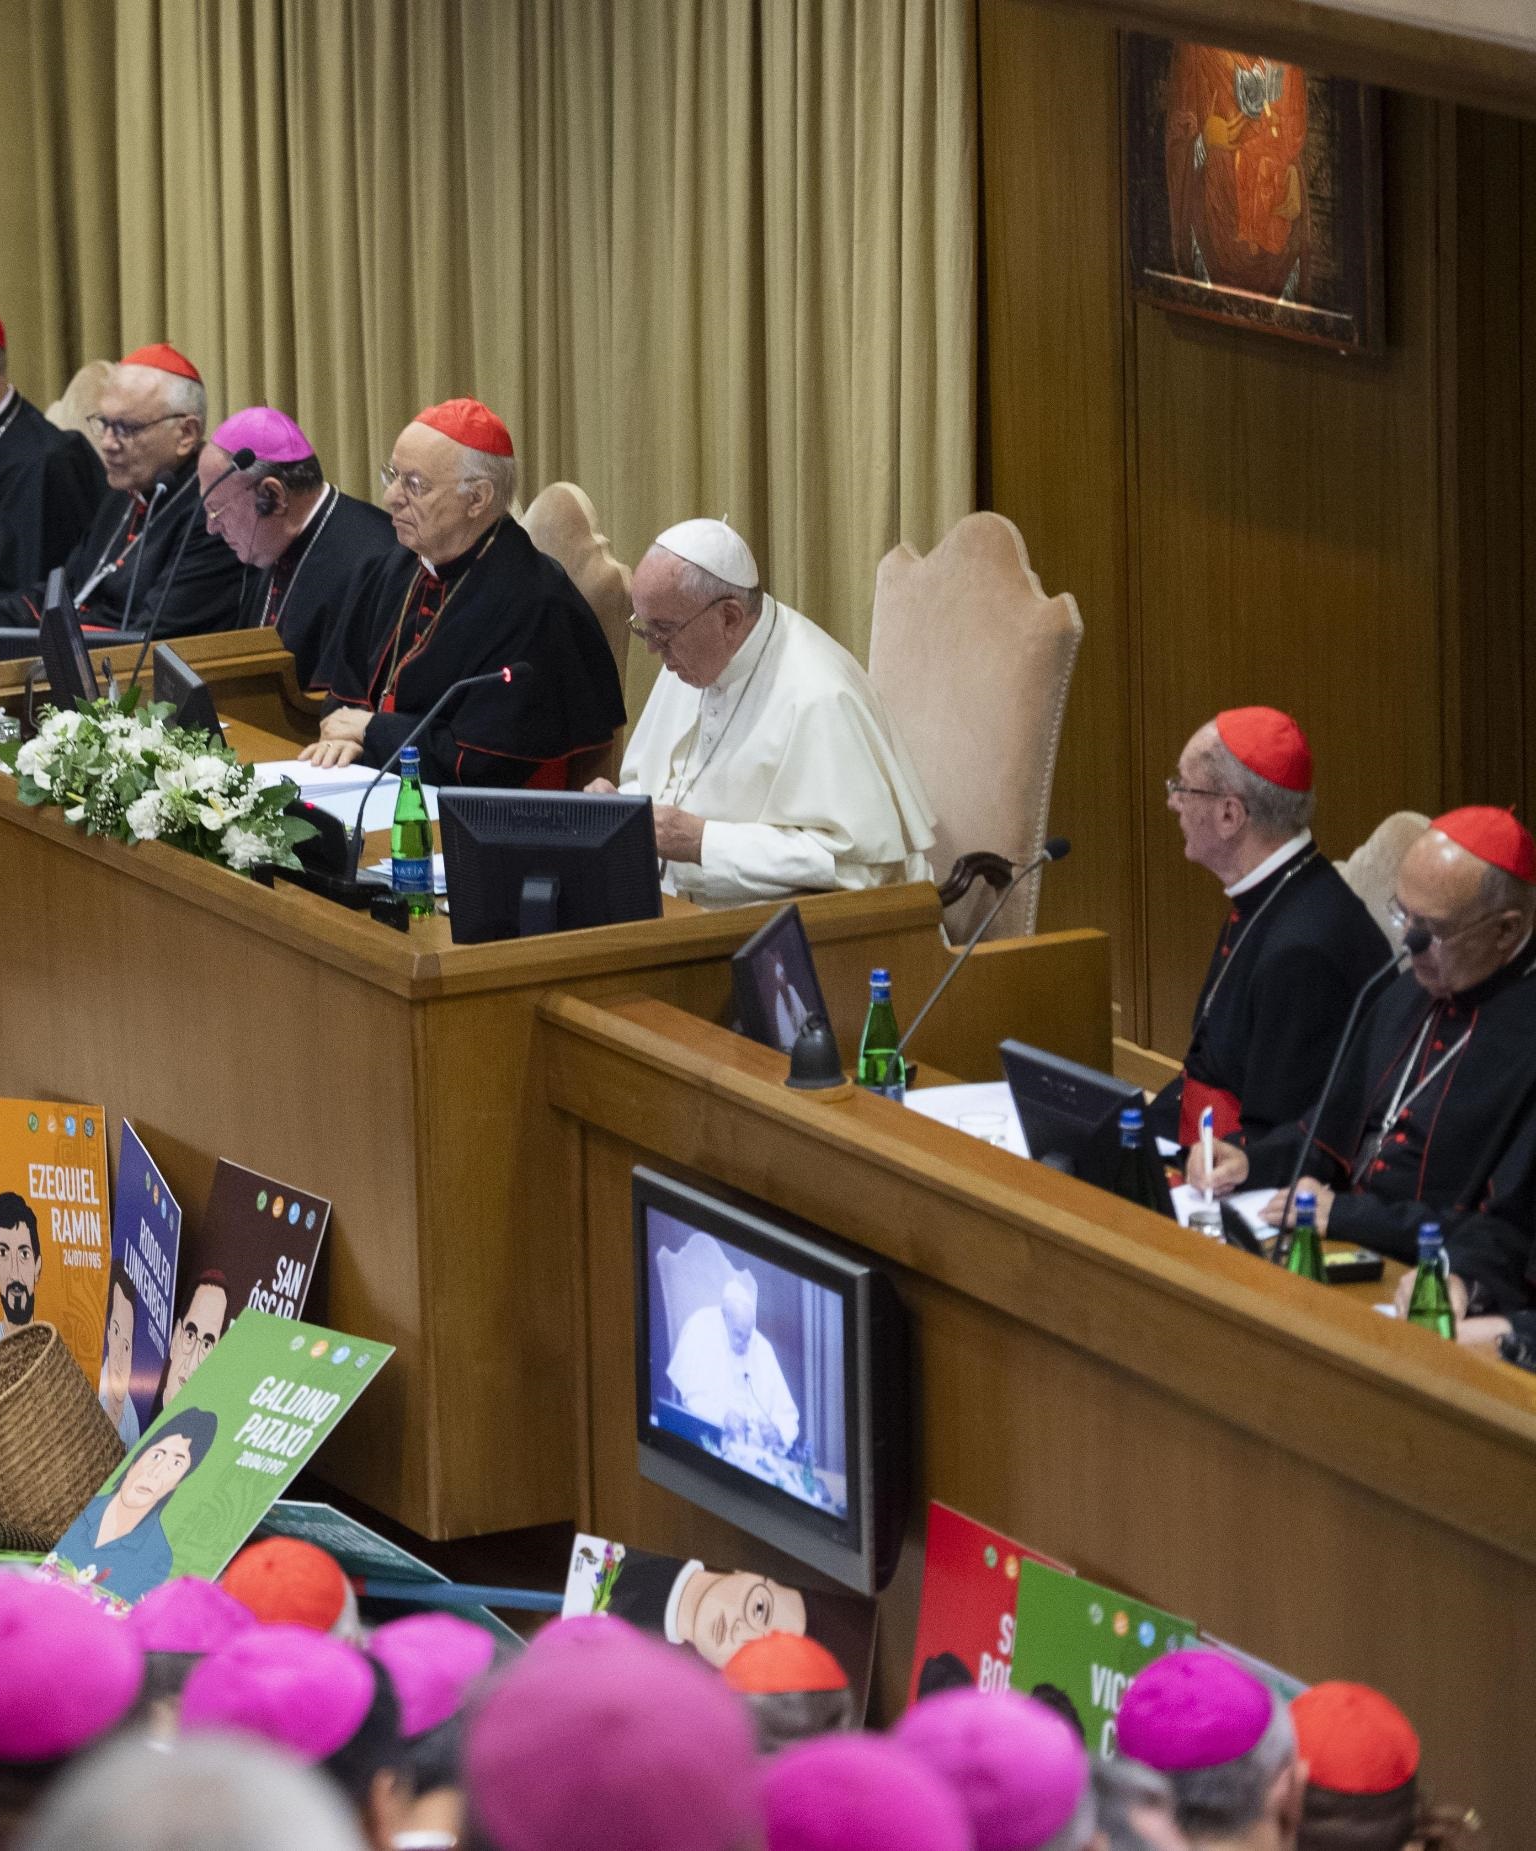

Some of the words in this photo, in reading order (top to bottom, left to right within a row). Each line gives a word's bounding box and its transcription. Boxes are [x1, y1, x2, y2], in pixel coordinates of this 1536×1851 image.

[28, 1163, 100, 1205] EZEQUIEL
[51, 1207, 101, 1246] RAMIN
[63, 1249, 101, 1270] 24/07/1985
[139, 1216, 170, 1297] RODOLFO
[272, 1255, 306, 1300] SAN
[124, 1238, 168, 1339] LUNKENBEIN
[249, 1376, 341, 1423] GALDINO
[233, 1412, 319, 1458] PATAXÓ
[1090, 1663, 1136, 1714] VIC
